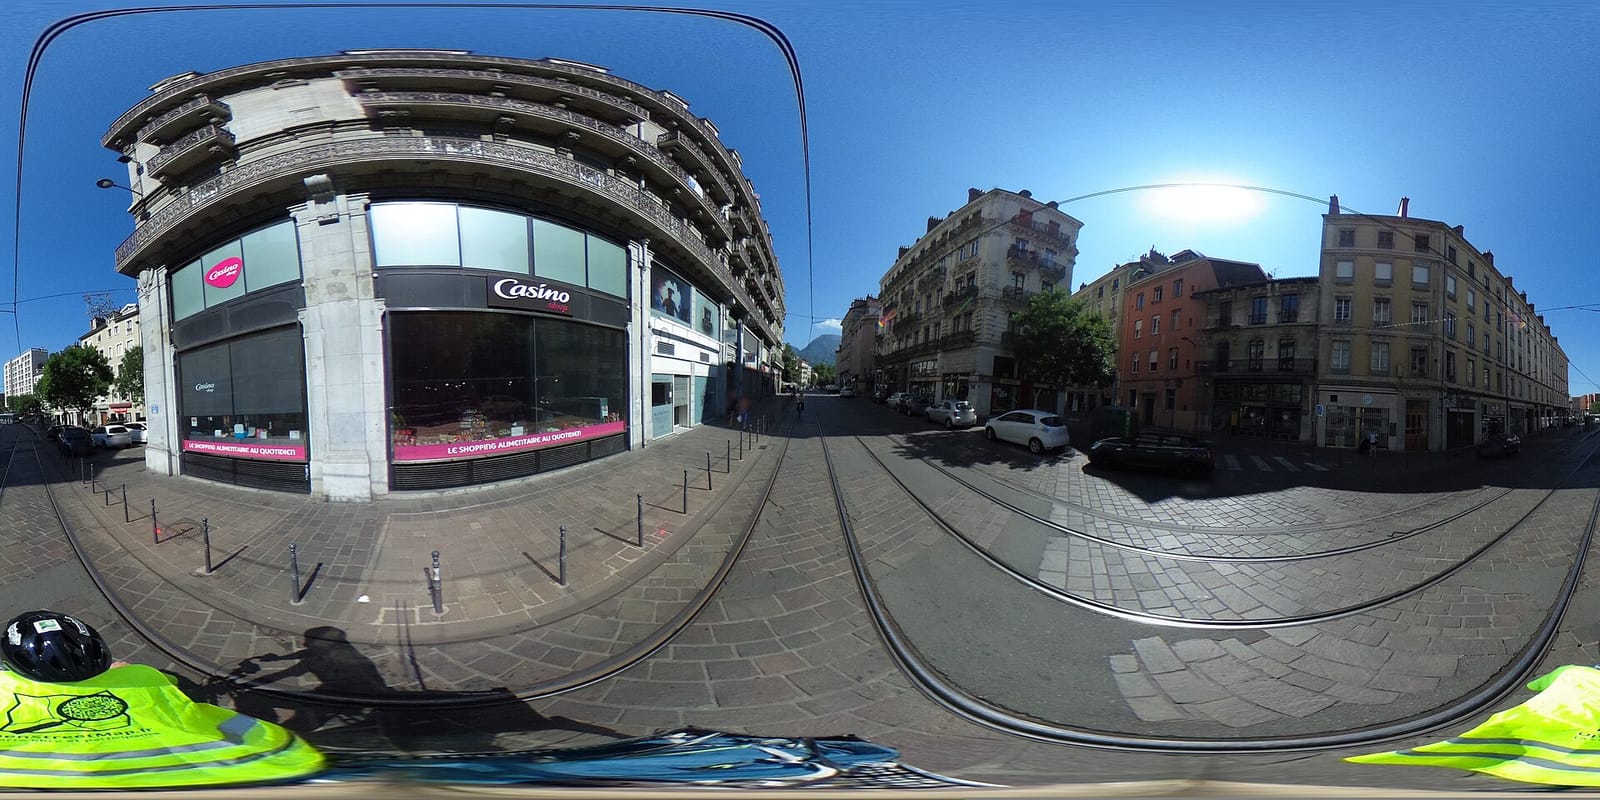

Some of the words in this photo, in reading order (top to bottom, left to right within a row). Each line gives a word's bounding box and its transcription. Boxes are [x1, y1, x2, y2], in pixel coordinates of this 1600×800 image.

[209, 263, 238, 280] Casino
[494, 279, 570, 303] Casino
[547, 303, 569, 313] shop
[260, 448, 296, 456] QUOTIDIEN
[459, 443, 497, 453] SHOPPING
[498, 437, 541, 449] ALIMENTAIRE
